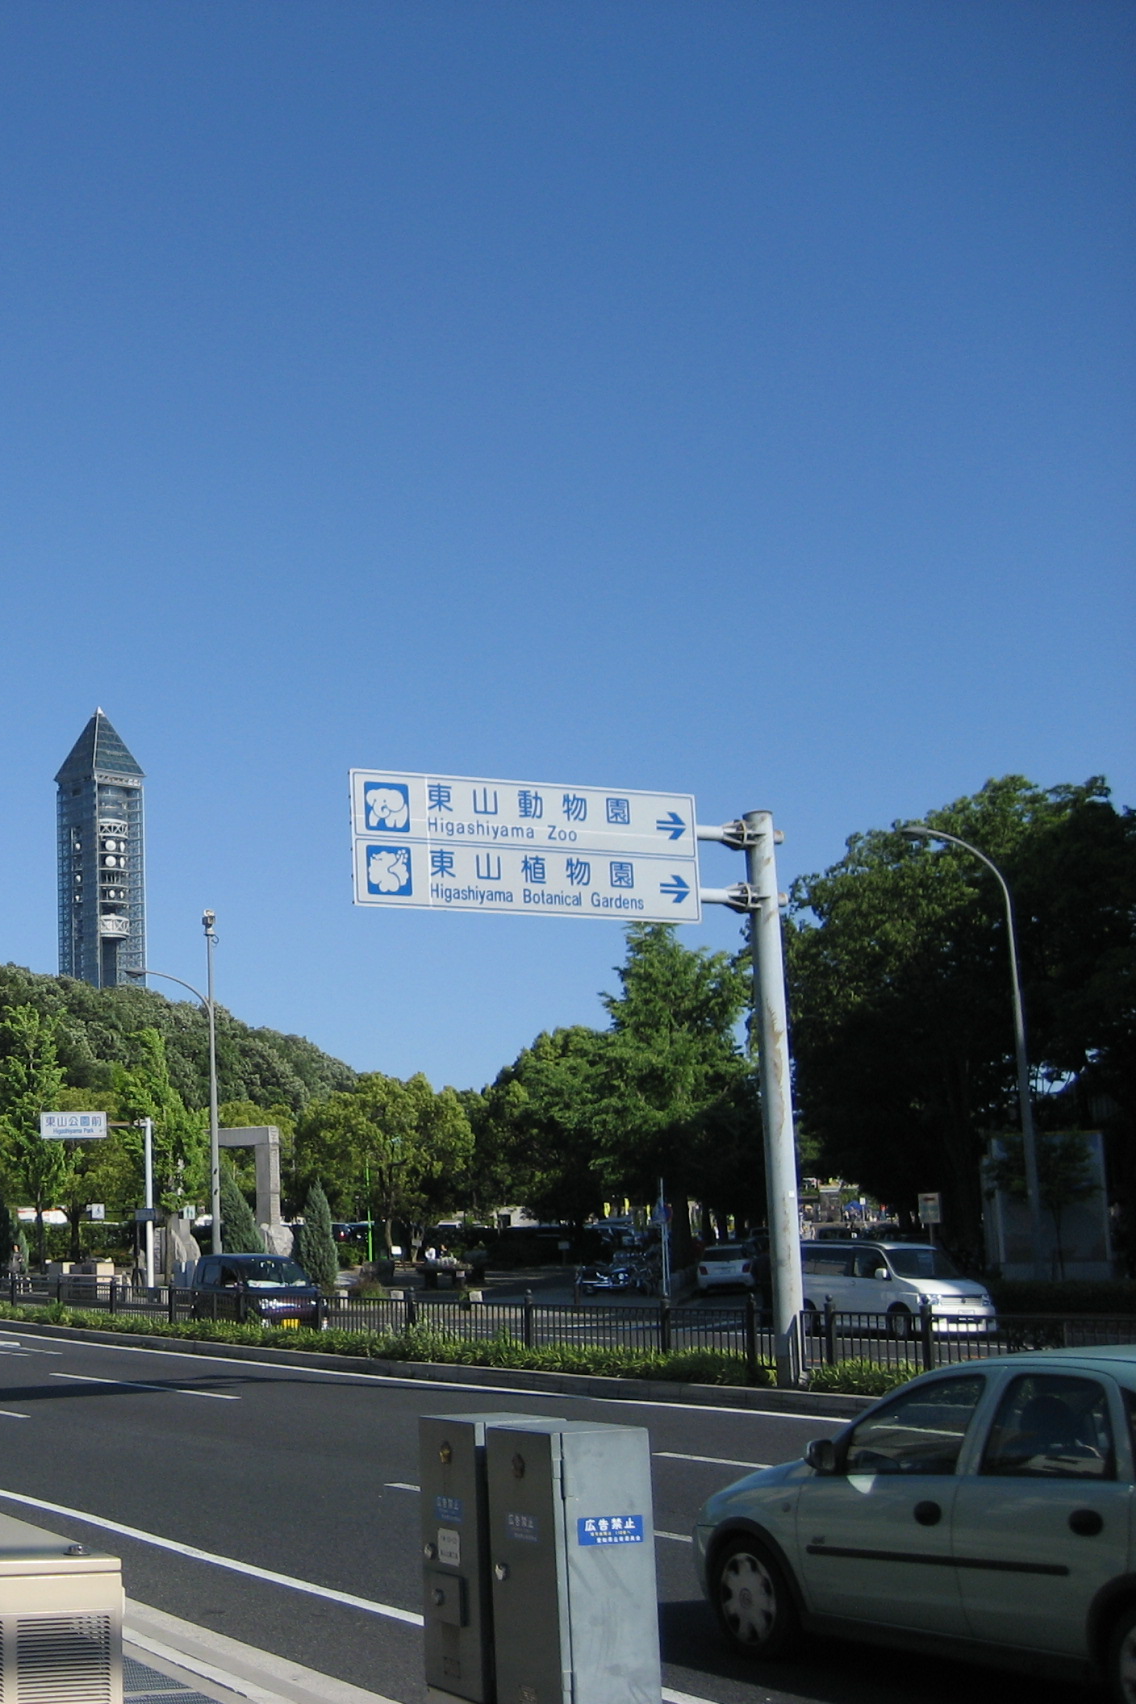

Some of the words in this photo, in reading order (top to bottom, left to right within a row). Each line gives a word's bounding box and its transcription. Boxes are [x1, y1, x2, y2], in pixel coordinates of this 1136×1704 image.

[428, 783, 631, 825] 東山動物園
[427, 816, 535, 840] Higashiyama
[548, 825, 578, 842] Zoo
[430, 848, 634, 889] 東山植物園
[430, 883, 514, 904] Higashiyama
[523, 888, 583, 907] Botanical
[590, 893, 645, 910] Gardens
[46, 1116, 102, 1127] 東山公園前
[584, 1517, 636, 1532] 広告禁止
